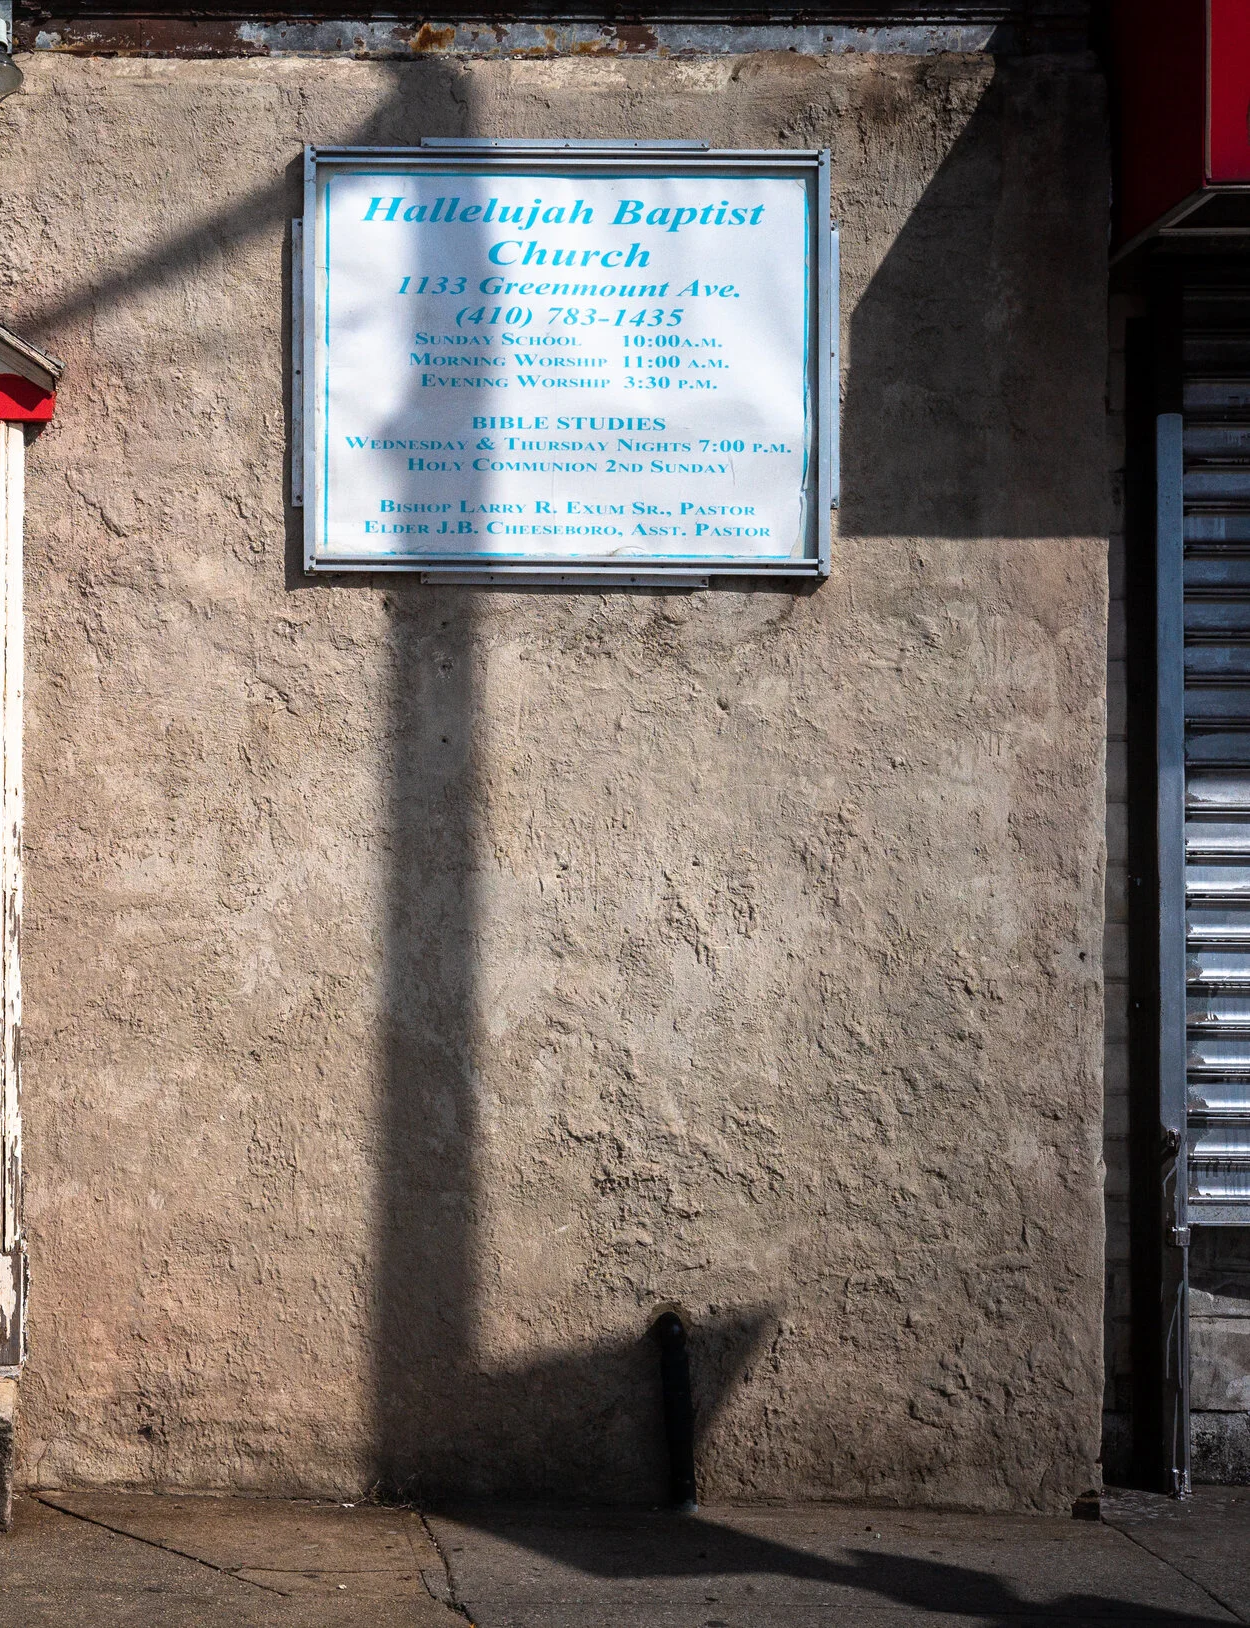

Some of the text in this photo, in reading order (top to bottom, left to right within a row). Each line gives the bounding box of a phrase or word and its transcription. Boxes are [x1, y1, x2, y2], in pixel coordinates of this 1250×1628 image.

[361, 194, 766, 232] Hallelujah Baptist
[487, 240, 651, 268] Church
[396, 274, 740, 298] 1133 Greenmount Ave.
[454, 305, 684, 328] (410) 783-1435
[414, 331, 494, 345] SUNDAY
[501, 332, 583, 345] SCHOOL
[409, 351, 729, 368] MORNING WORSHIP 11:00 A.M.
[421, 372, 718, 389] EVENING WORSHIP 3:30 P.M.
[471, 415, 666, 430] BIBLE STUDIES
[345, 436, 792, 453] WEDNESDAY & THURSDAY NIGHTS 7:00 P.M.
[407, 456, 726, 473] HOLY COMMUNION 2ND SUNDAY
[380, 499, 755, 516] BISHOP LARRY R. EXUM SR., PASTOR
[365, 519, 770, 536] ELDER J.B. CHEESEBORO, ASST. PASTOR
